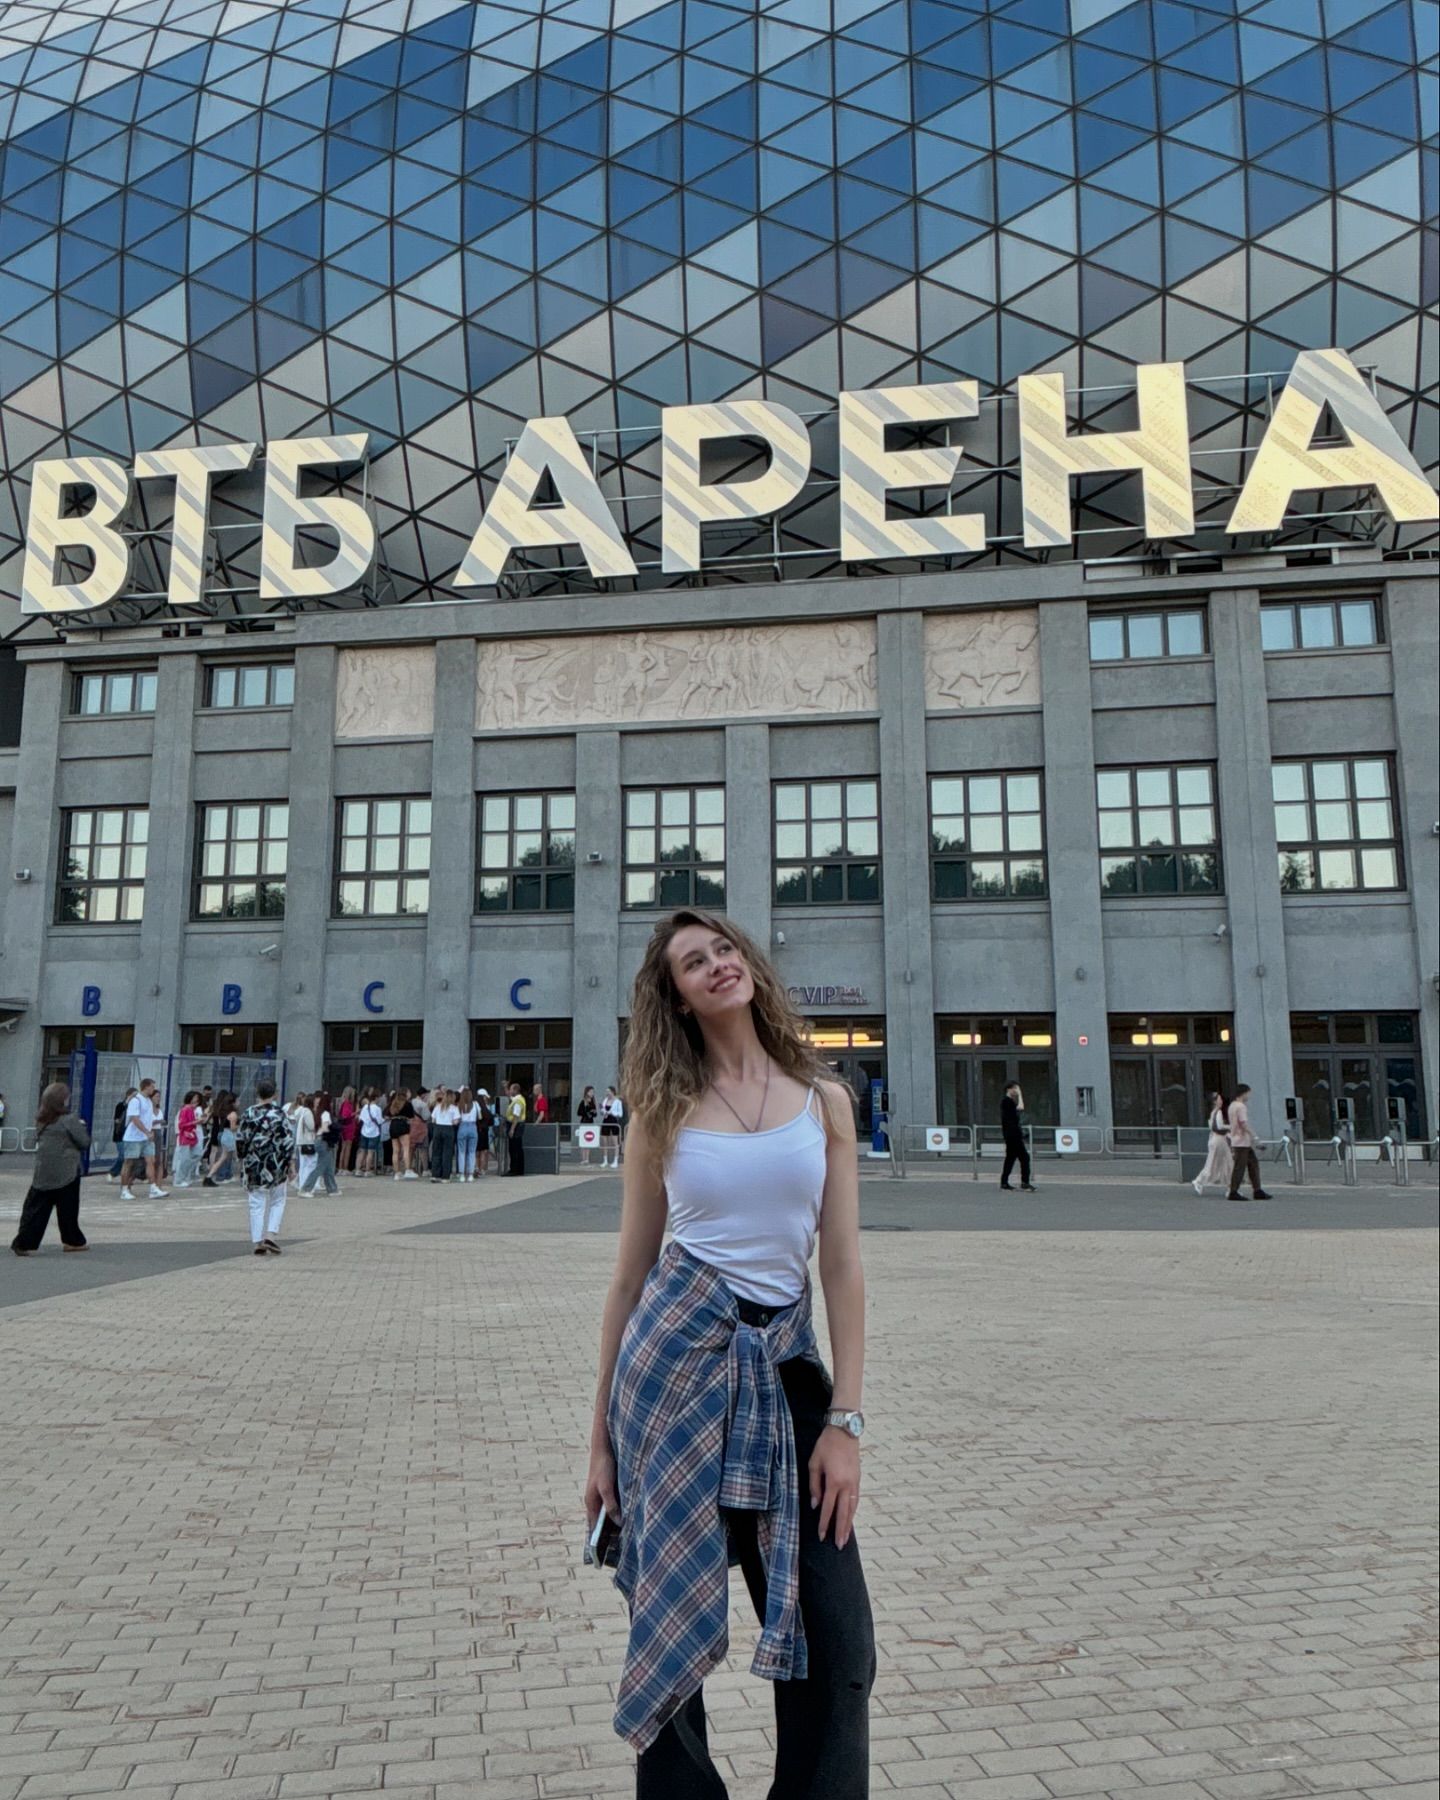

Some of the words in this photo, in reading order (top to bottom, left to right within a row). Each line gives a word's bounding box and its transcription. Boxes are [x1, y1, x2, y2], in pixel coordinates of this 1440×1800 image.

[21, 432, 378, 615] ВТБ
[452, 347, 1439, 588] АРЕНА
[82, 985, 101, 1016] B
[222, 984, 242, 1015] B
[363, 981, 385, 1013] C
[510, 978, 532, 1010] C
[804, 985, 837, 1005] VIP
